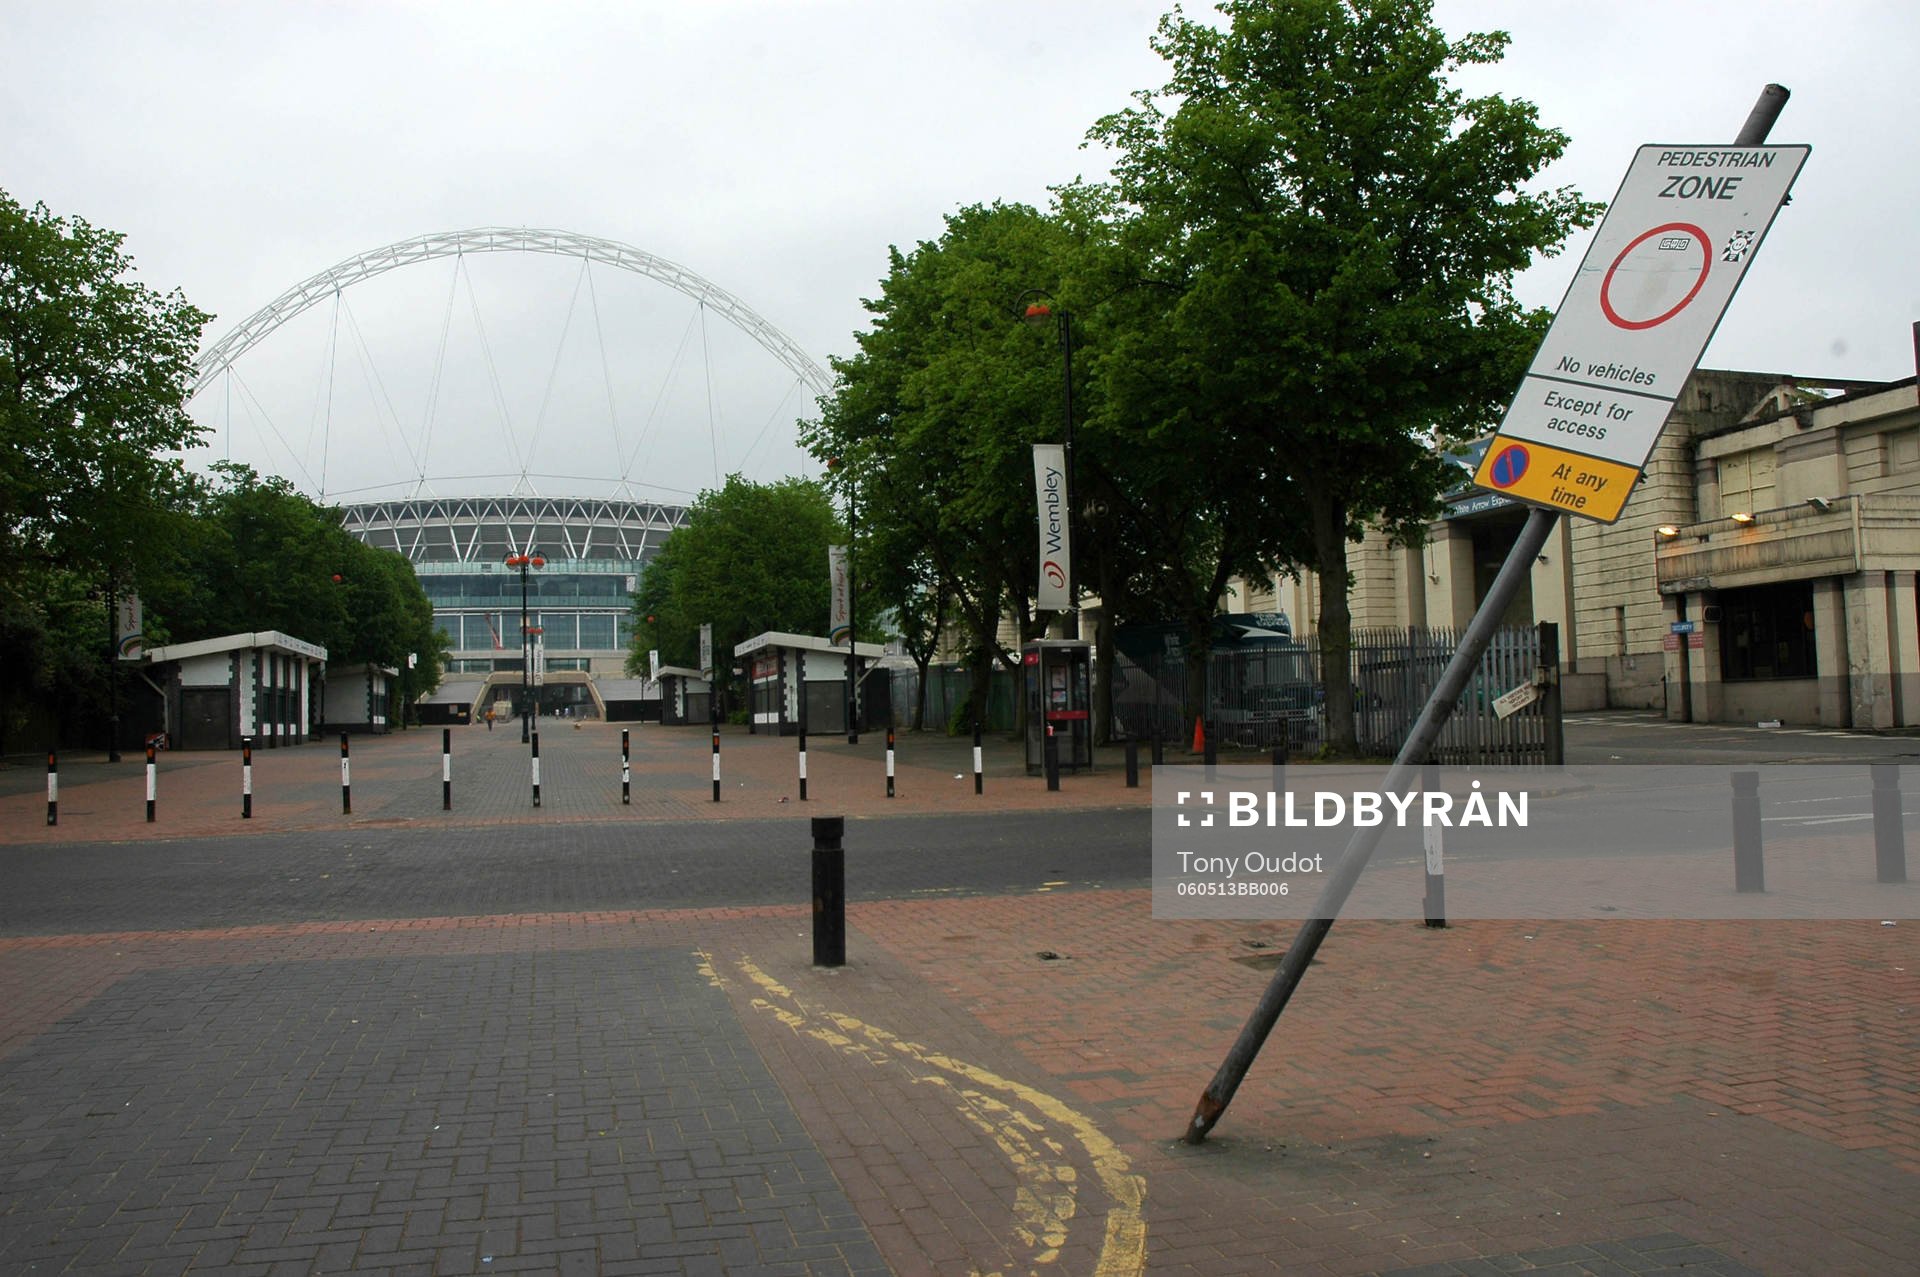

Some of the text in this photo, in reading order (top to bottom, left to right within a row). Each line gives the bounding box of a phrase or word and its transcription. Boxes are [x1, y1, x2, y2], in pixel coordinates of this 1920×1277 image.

[1657, 151, 1776, 168] PEDESTRIAN
[1657, 176, 1744, 200] ZONE
[1556, 355, 1656, 385] No vehicles
[1544, 390, 1634, 422] Except for
[1547, 417, 1607, 440] access
[1551, 463, 1608, 492] At any
[1472, 499, 1490, 512] Arrow
[1550, 486, 1586, 509] time
[1044, 467, 1063, 556] Wembley
